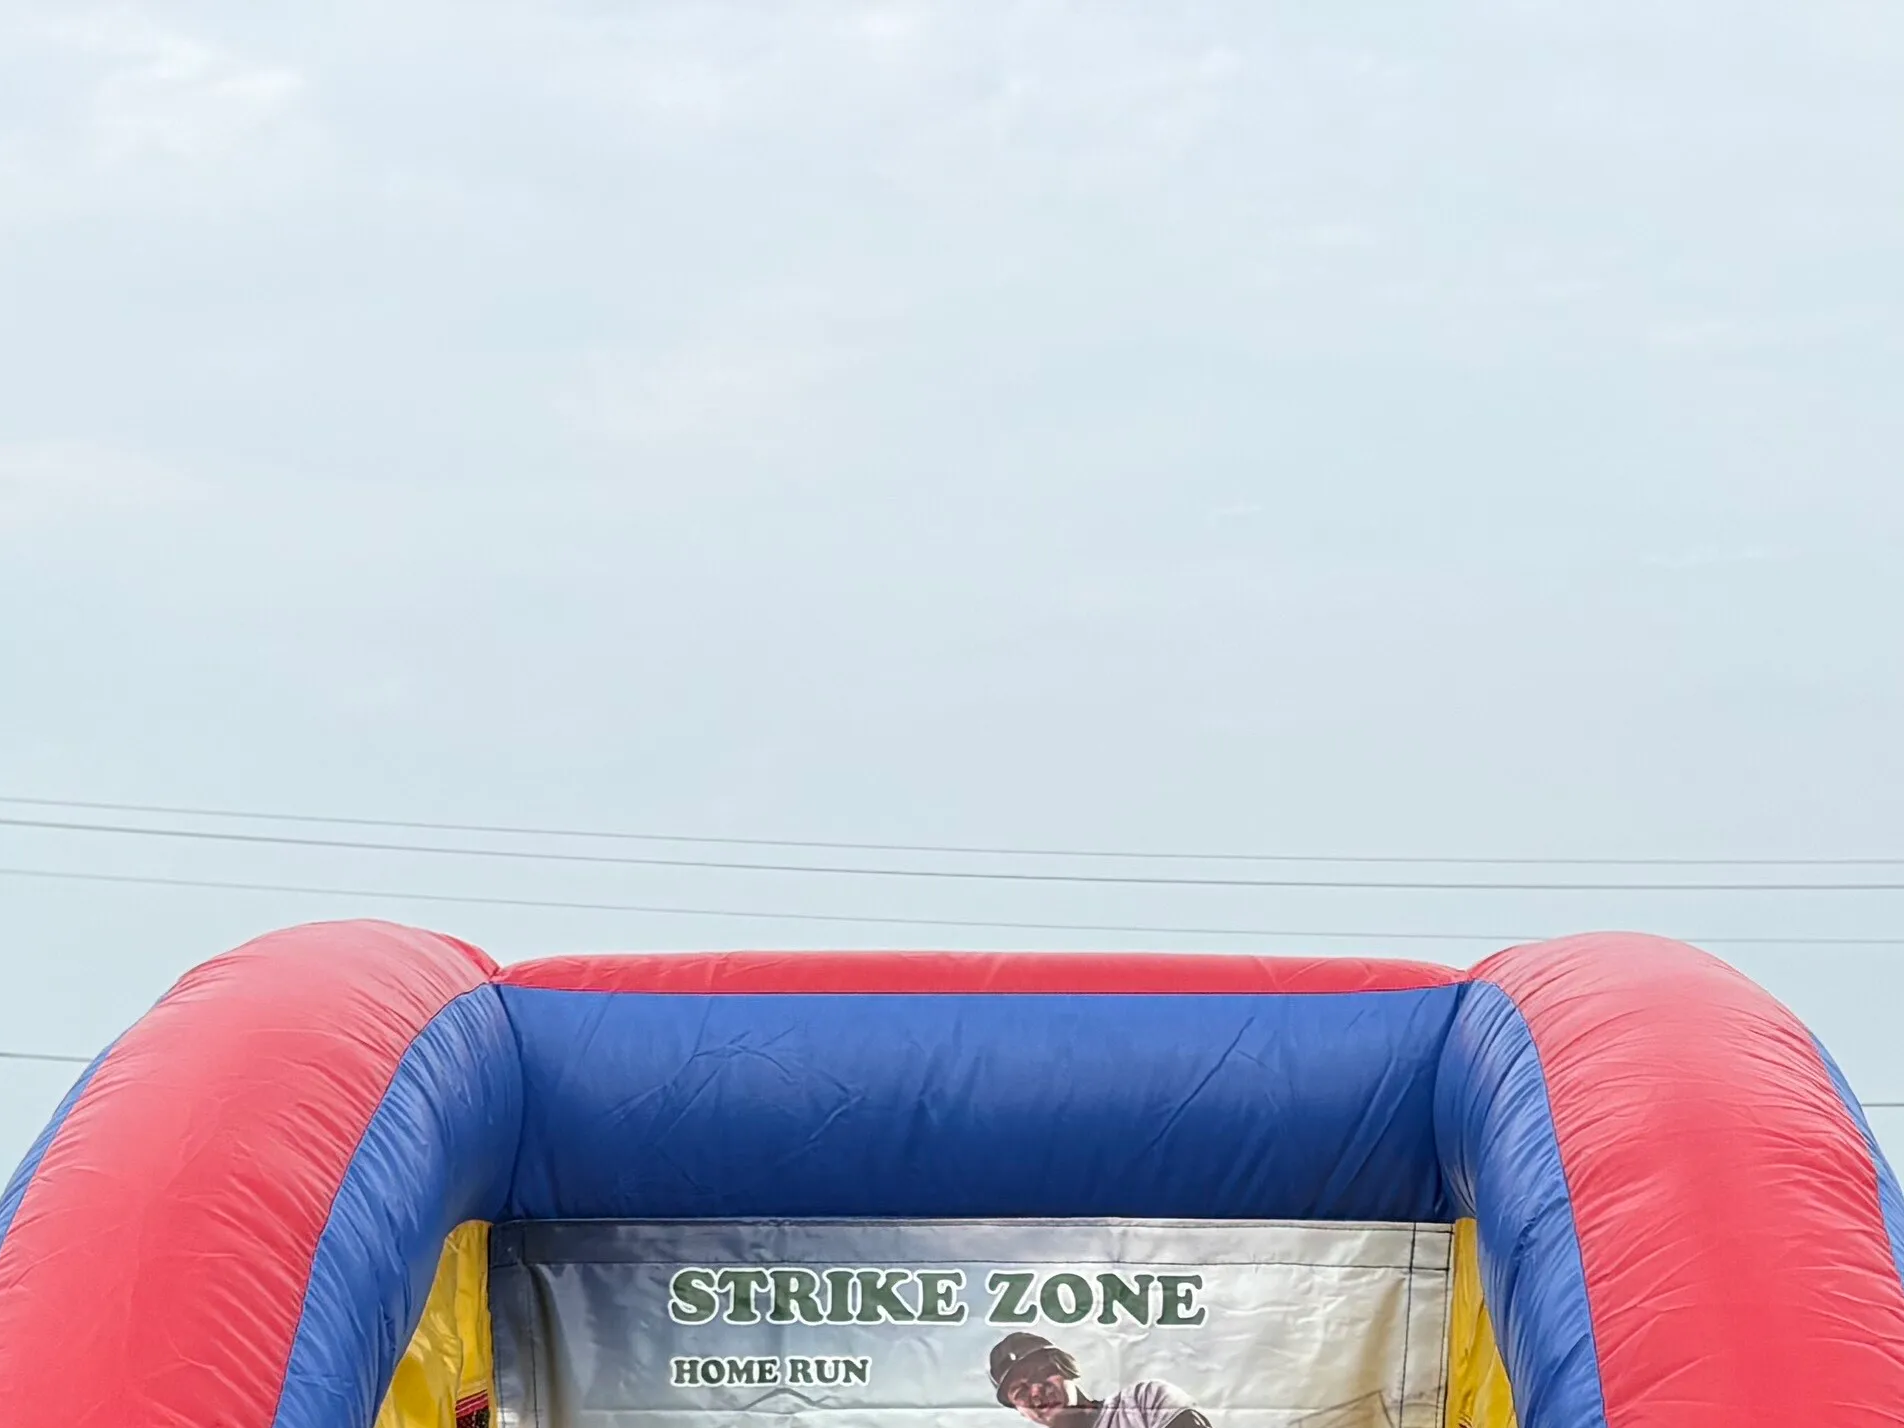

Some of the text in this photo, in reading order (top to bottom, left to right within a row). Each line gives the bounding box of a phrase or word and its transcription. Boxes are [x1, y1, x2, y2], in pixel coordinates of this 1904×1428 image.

[669, 1268, 1208, 1327] STRIKE ZONE
[672, 1357, 871, 1386] HOME RUN
